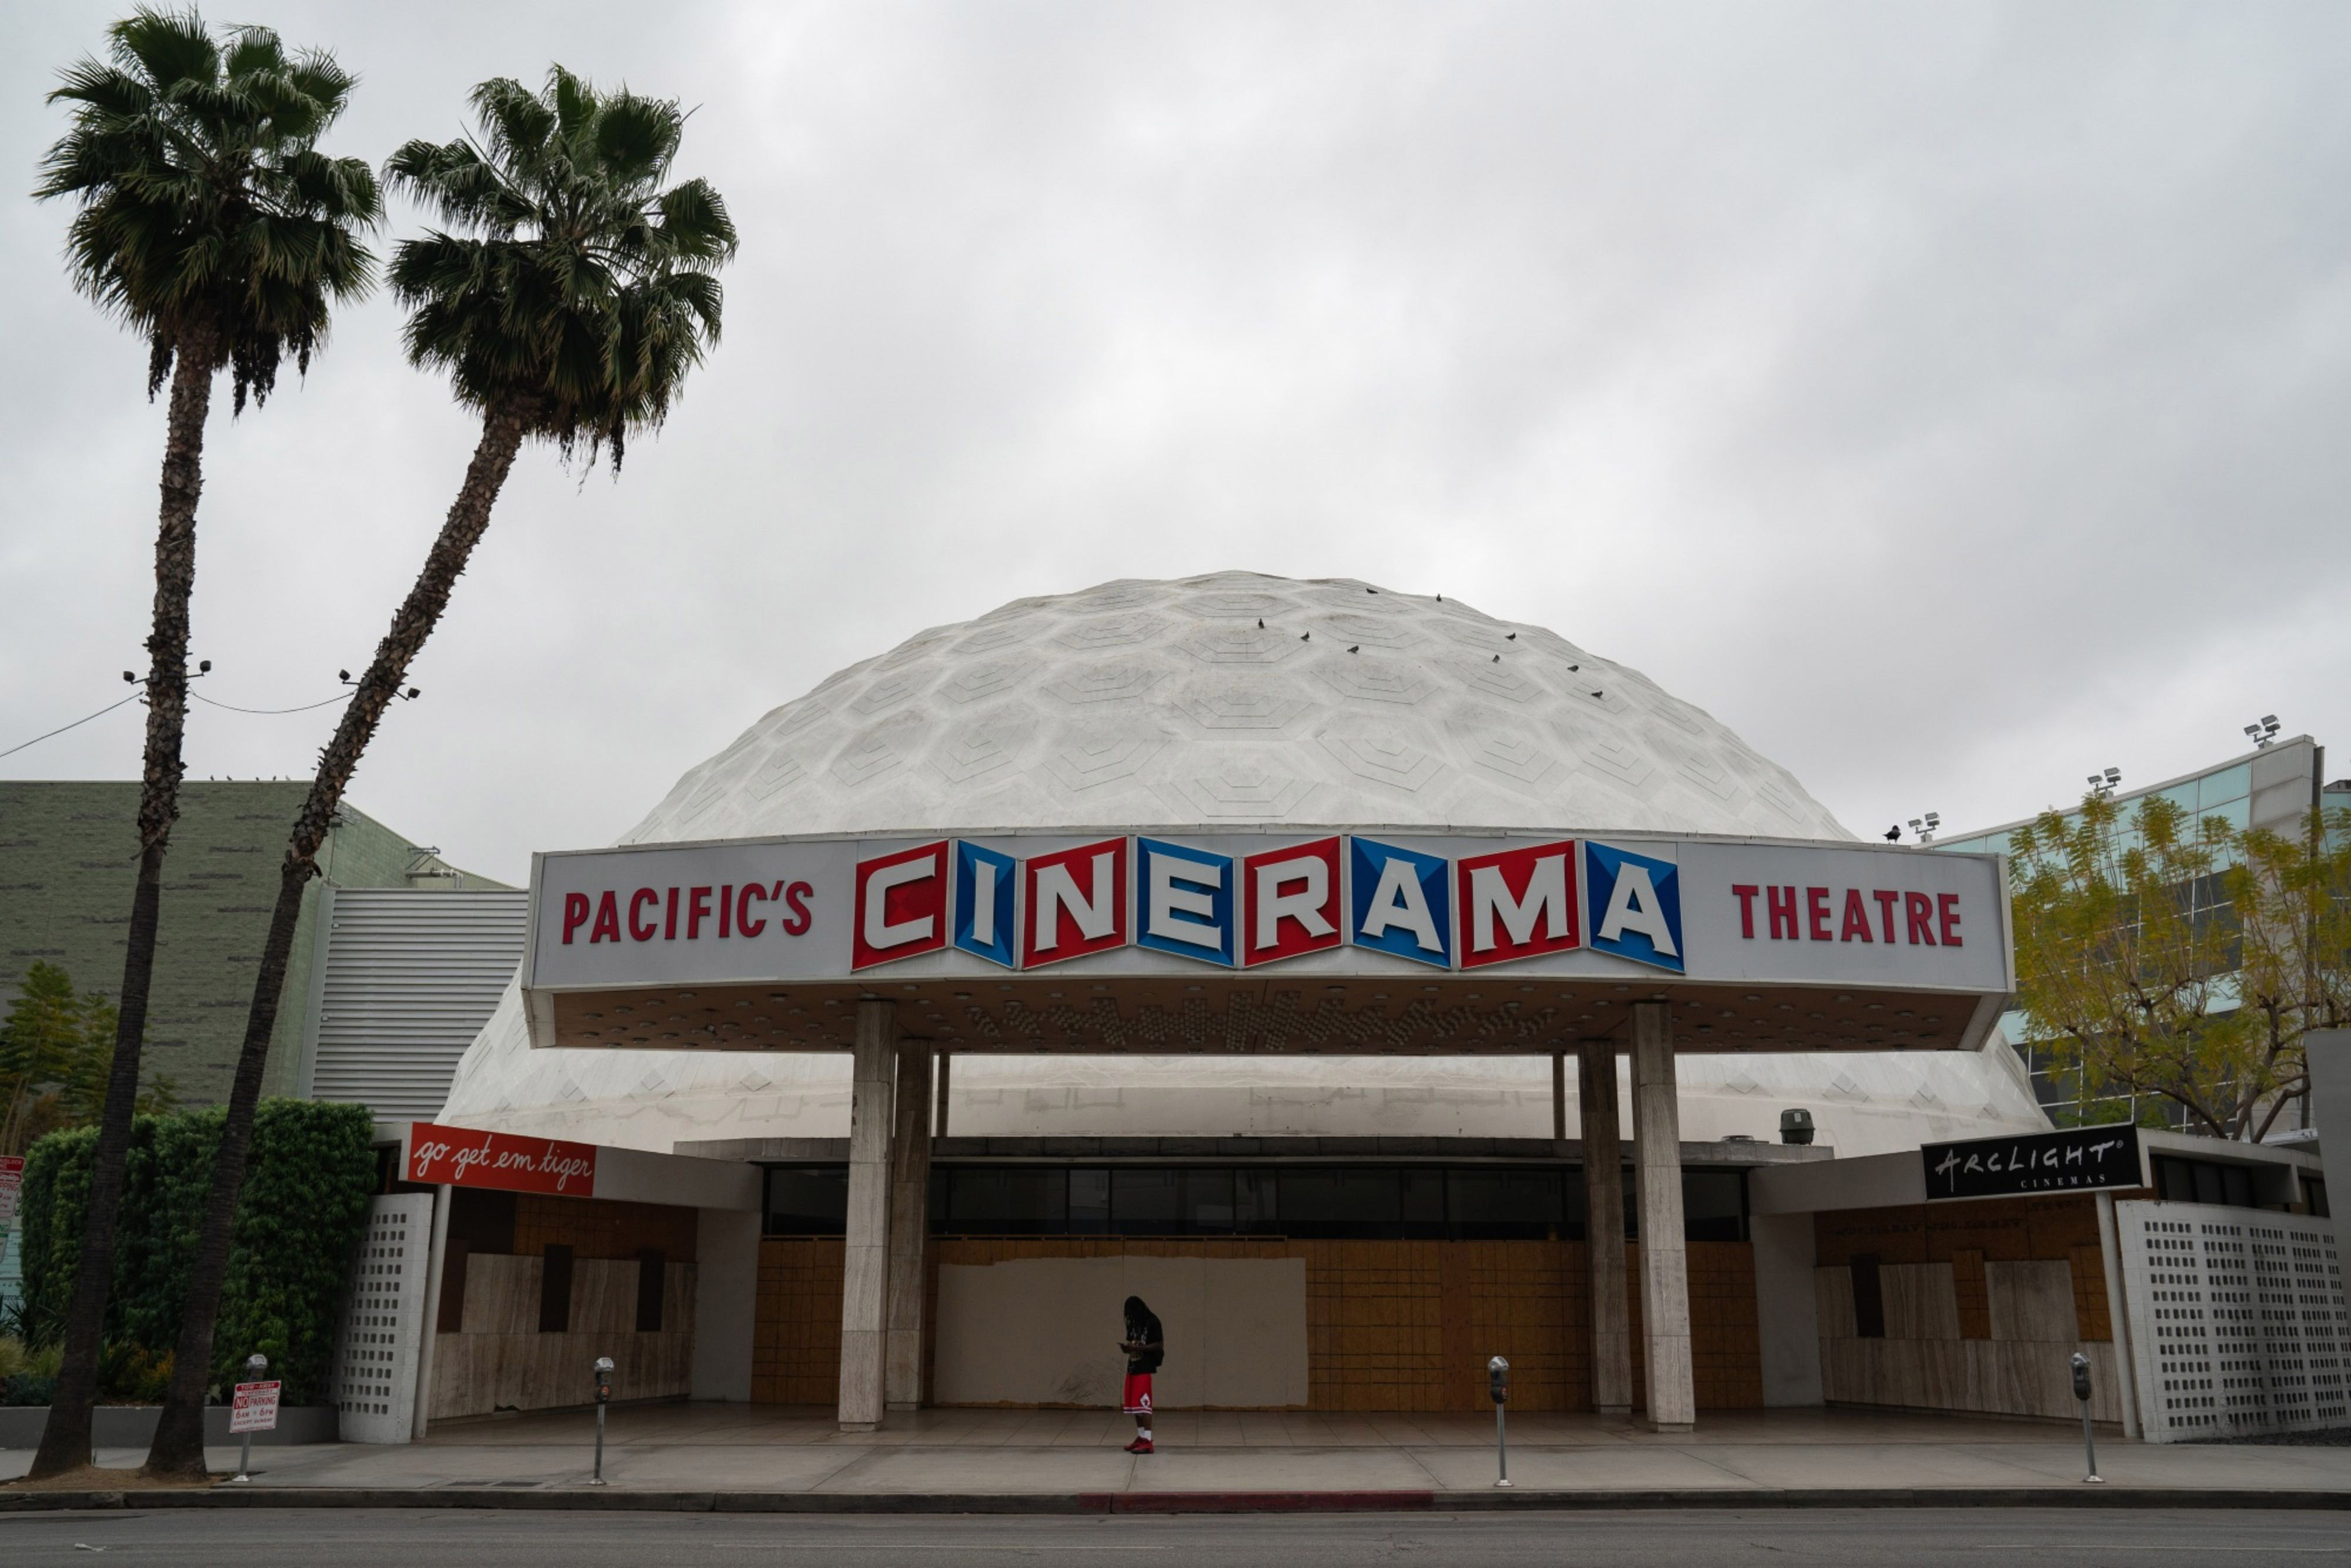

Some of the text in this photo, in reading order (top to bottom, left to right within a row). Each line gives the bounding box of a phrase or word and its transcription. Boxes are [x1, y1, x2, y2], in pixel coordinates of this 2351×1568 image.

[562, 850, 1964, 957] PACIFIC'S CINERAMA THEATRE
[414, 1134, 593, 1191] go get em tiger
[2020, 1174, 2106, 1189] CINEMAS
[236, 1396, 276, 1409] NO PARKING
